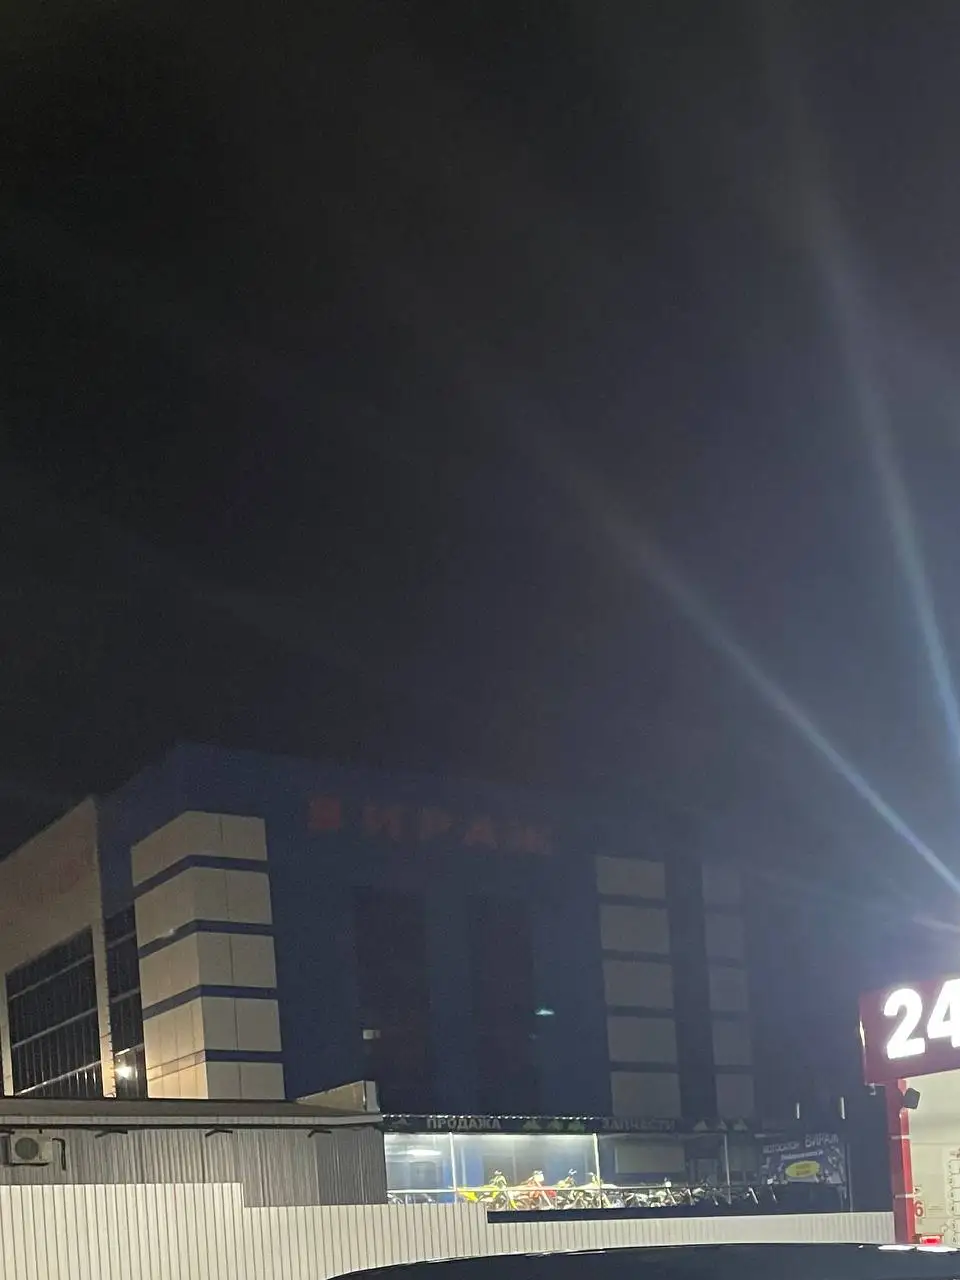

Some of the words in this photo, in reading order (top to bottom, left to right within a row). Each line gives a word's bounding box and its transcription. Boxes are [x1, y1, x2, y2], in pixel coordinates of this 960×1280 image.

[426, 1117, 502, 1131] ПРОДАЖА
[602, 1118, 676, 1132] ЗАПЧАСТИ
[914, 1200, 924, 1218] 6
